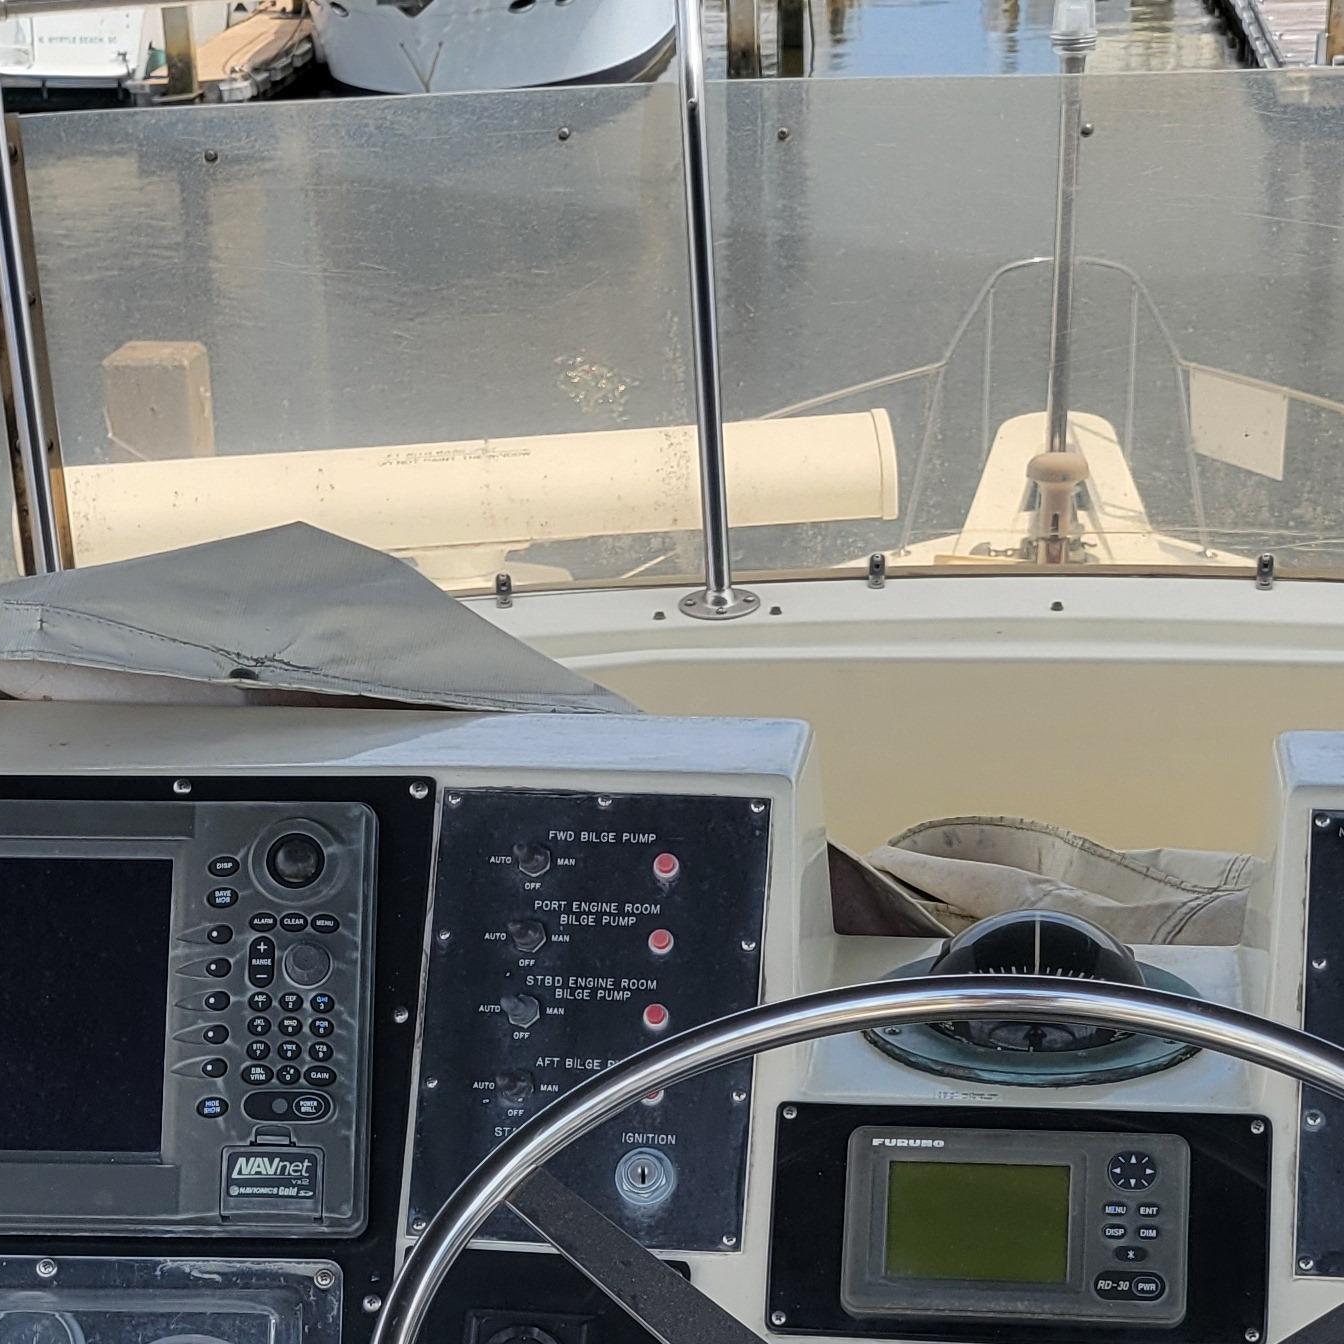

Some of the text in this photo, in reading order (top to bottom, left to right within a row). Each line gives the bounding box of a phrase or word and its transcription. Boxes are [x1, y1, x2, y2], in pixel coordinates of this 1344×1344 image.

[548, 831, 657, 844] FWD BILGE PUMP
[489, 855, 512, 865] AUTO
[557, 857, 576, 867] MAN
[524, 881, 542, 891] OFF
[534, 900, 661, 915] PORT ENGINE ROOM
[559, 914, 637, 927] BILGE PUMP
[484, 932, 506, 941] AUTO
[551, 933, 570, 943] MAN
[518, 958, 536, 968] OFF
[525, 975, 657, 990] STBD ENGINE ROOM
[555, 988, 631, 1001] BILGE PUMP
[478, 1004, 501, 1014] AUTO
[546, 1006, 565, 1016] MAN
[512, 1031, 531, 1040] OFF
[535, 1057, 560, 1069] AFT
[565, 1057, 601, 1070] BILGE
[472, 1081, 495, 1090] AUTO
[540, 1083, 559, 1093] MAN
[507, 1108, 524, 1118] OFF
[621, 1132, 676, 1146] IGNITION
[871, 1138, 945, 1148] FURUNO
[231, 1156, 313, 1178] NAVnet
[278, 1186, 298, 1196] Gold
[1105, 1205, 1127, 1214] MENU
[1139, 1206, 1159, 1215] ENT
[1105, 1228, 1125, 1236] DISP
[1139, 1229, 1157, 1237] DIM
[1096, 1280, 1130, 1291] RD-30
[1137, 1282, 1157, 1291] PWR
